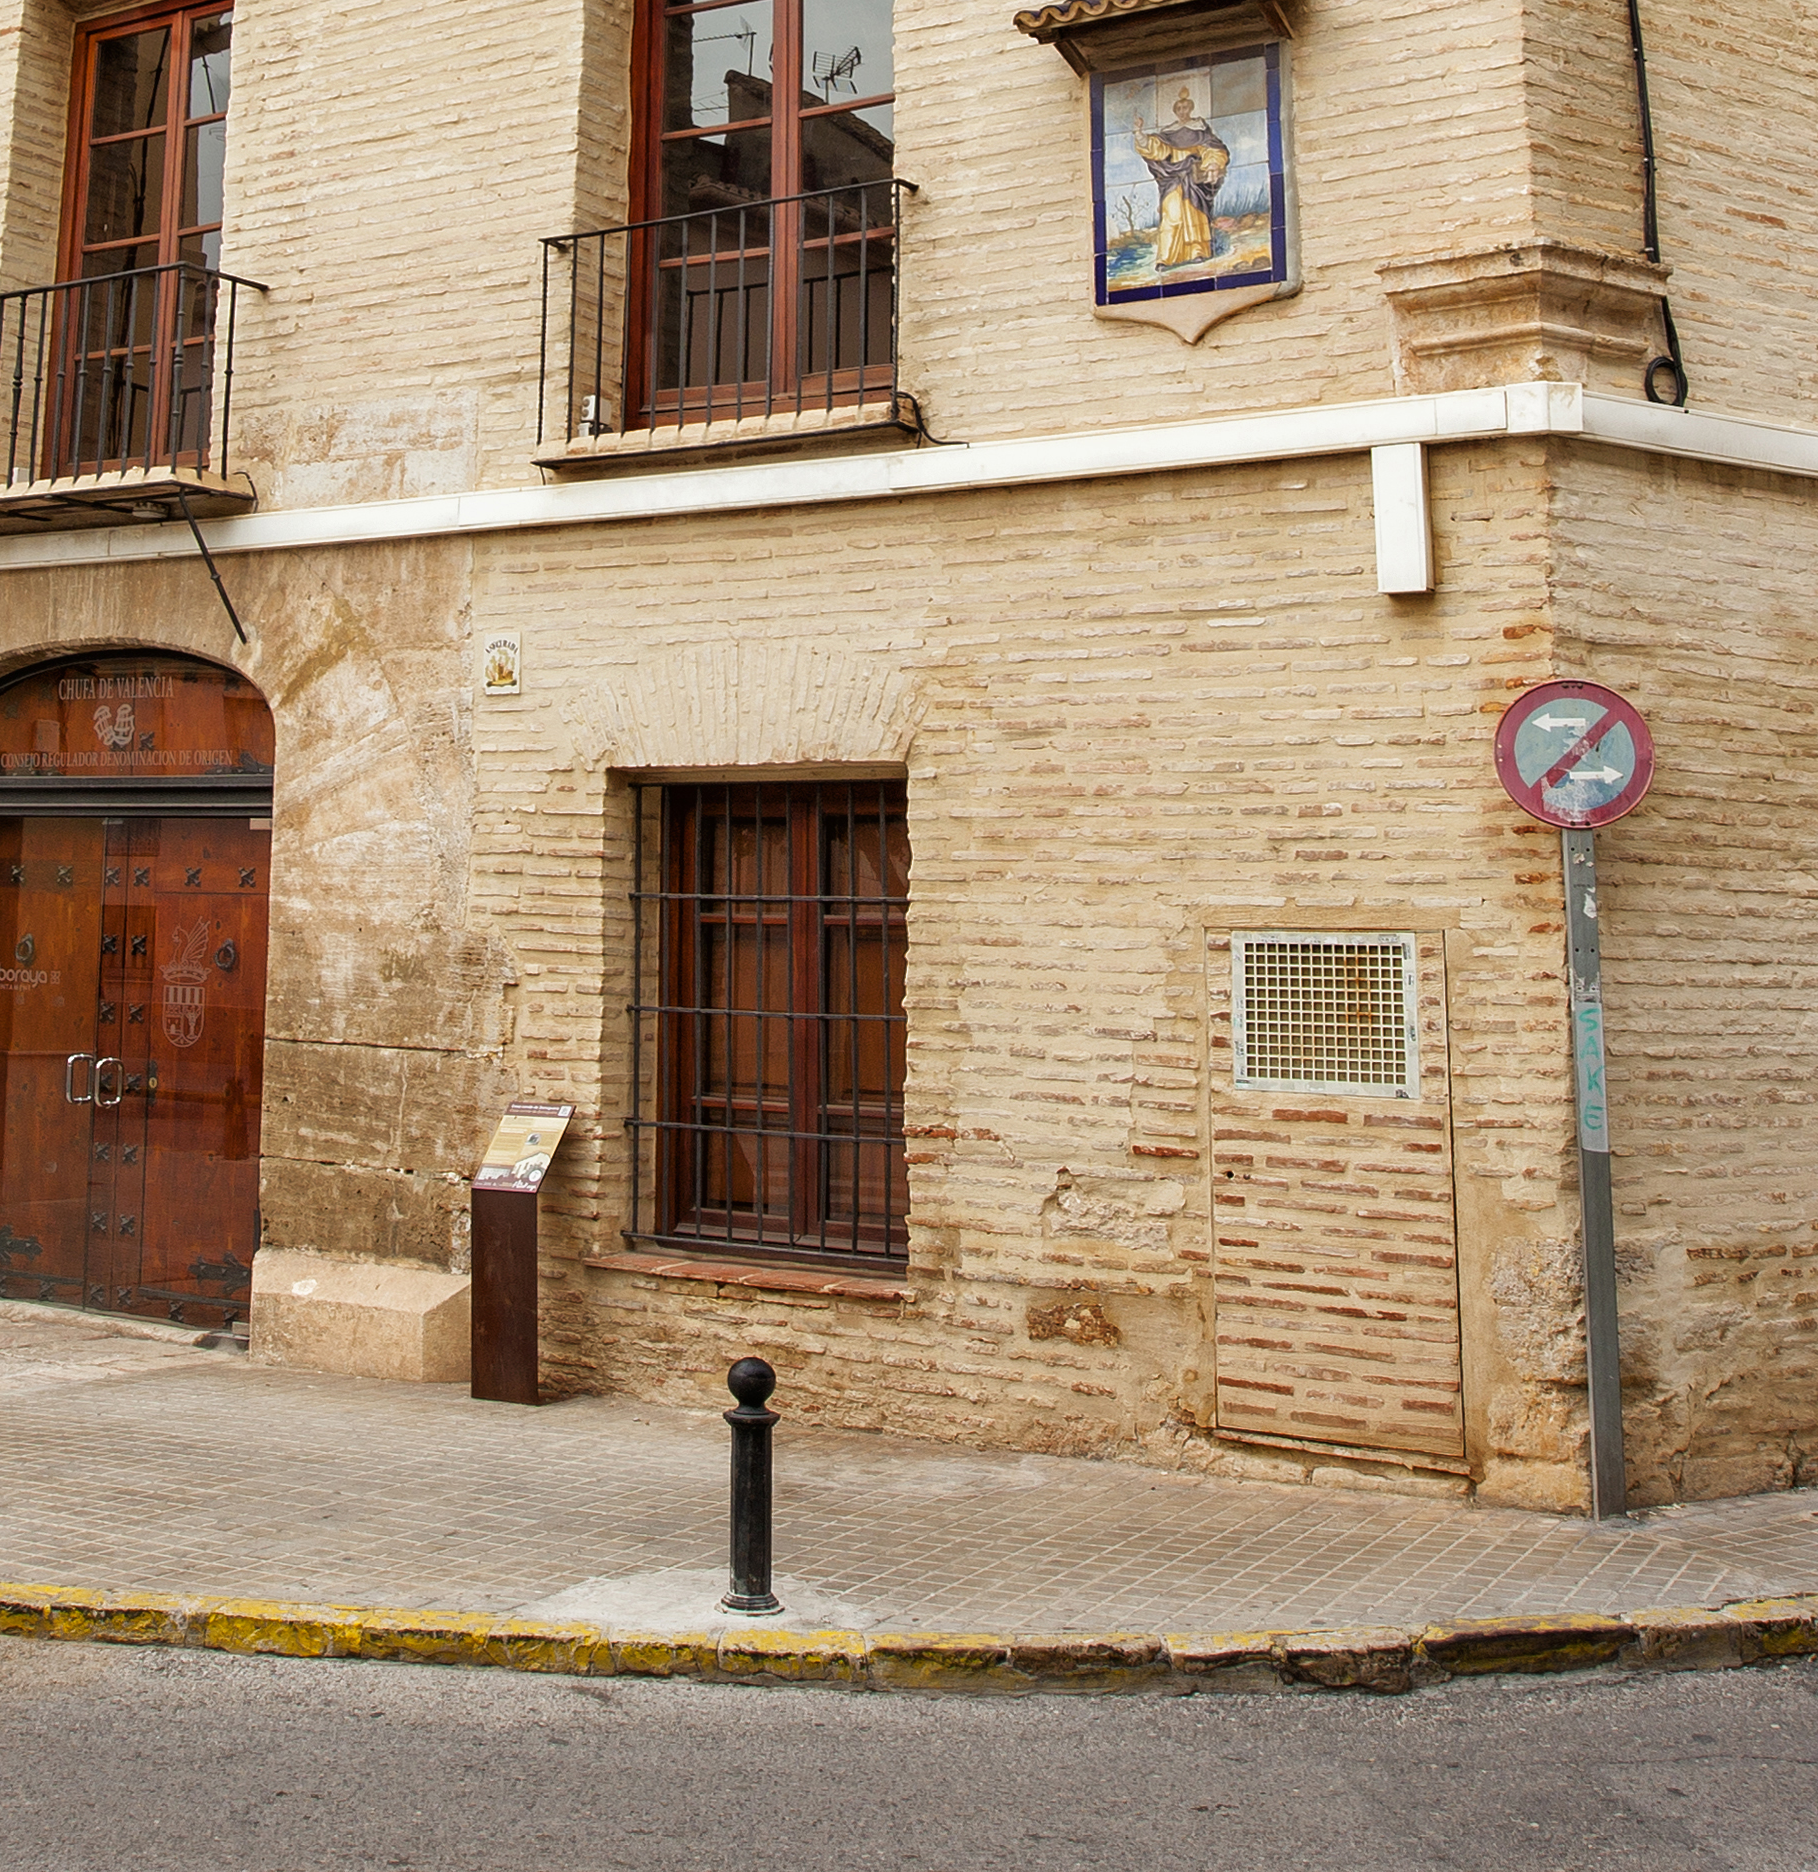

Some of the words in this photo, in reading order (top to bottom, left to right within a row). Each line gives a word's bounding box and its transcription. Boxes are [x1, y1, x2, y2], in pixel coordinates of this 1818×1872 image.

[58, 678, 96, 701] CHUFA
[98, 677, 114, 699] DE
[116, 676, 174, 699] VALENCIA
[1, 752, 41, 768] CONSEJO
[41, 751, 99, 767] REGULADOR
[99, 750, 177, 767] DENOMINACION
[178, 750, 192, 766] DE
[193, 749, 233, 766] ORIGEN
[1578, 1008, 1605, 1130] SAKE
